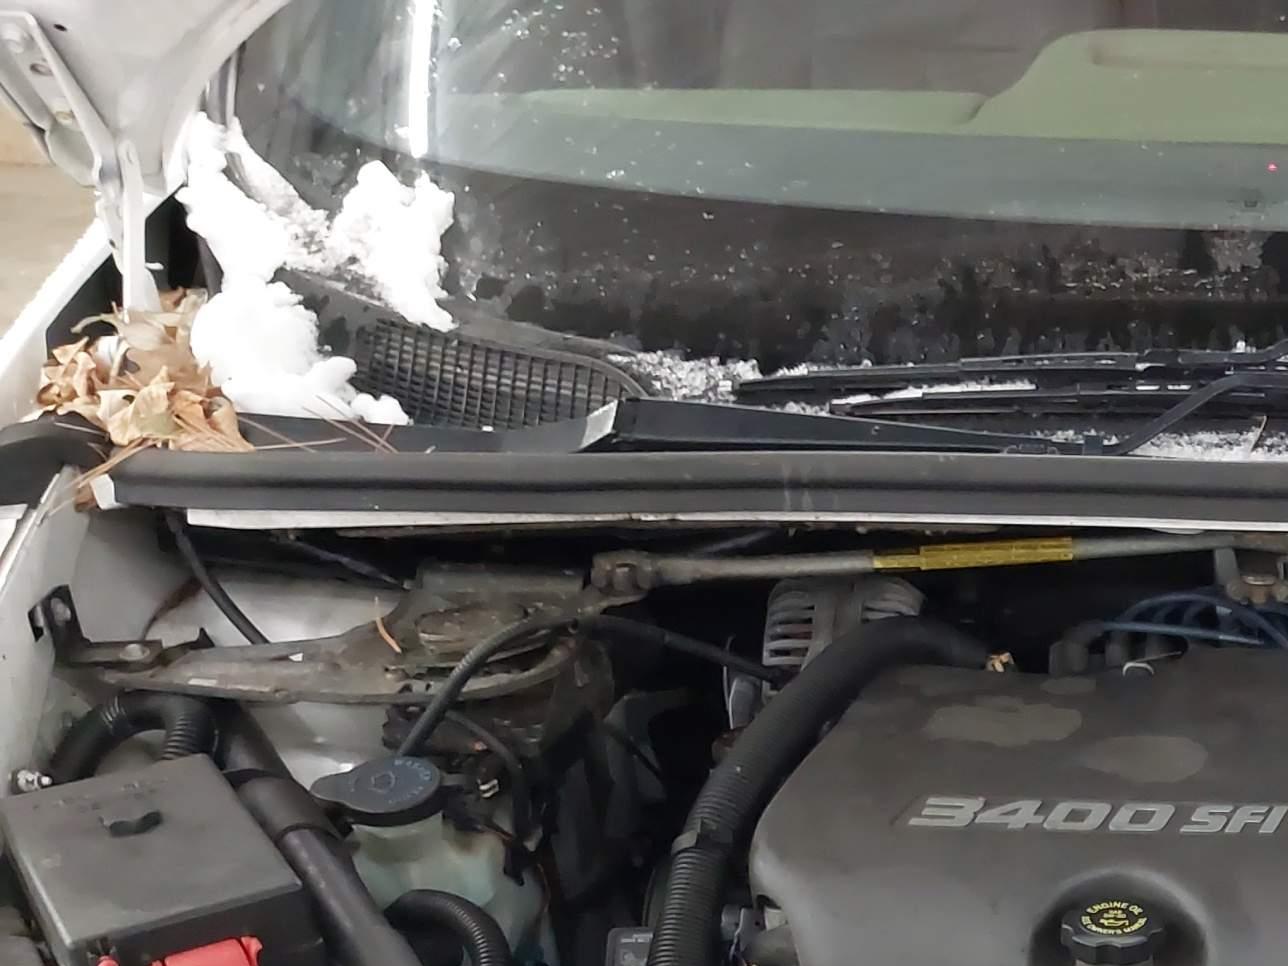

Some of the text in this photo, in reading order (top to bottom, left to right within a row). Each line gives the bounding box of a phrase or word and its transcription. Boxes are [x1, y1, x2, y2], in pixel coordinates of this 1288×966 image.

[908, 797, 1288, 833] 3400 SFI
[1086, 901, 1129, 914] ENGINE
